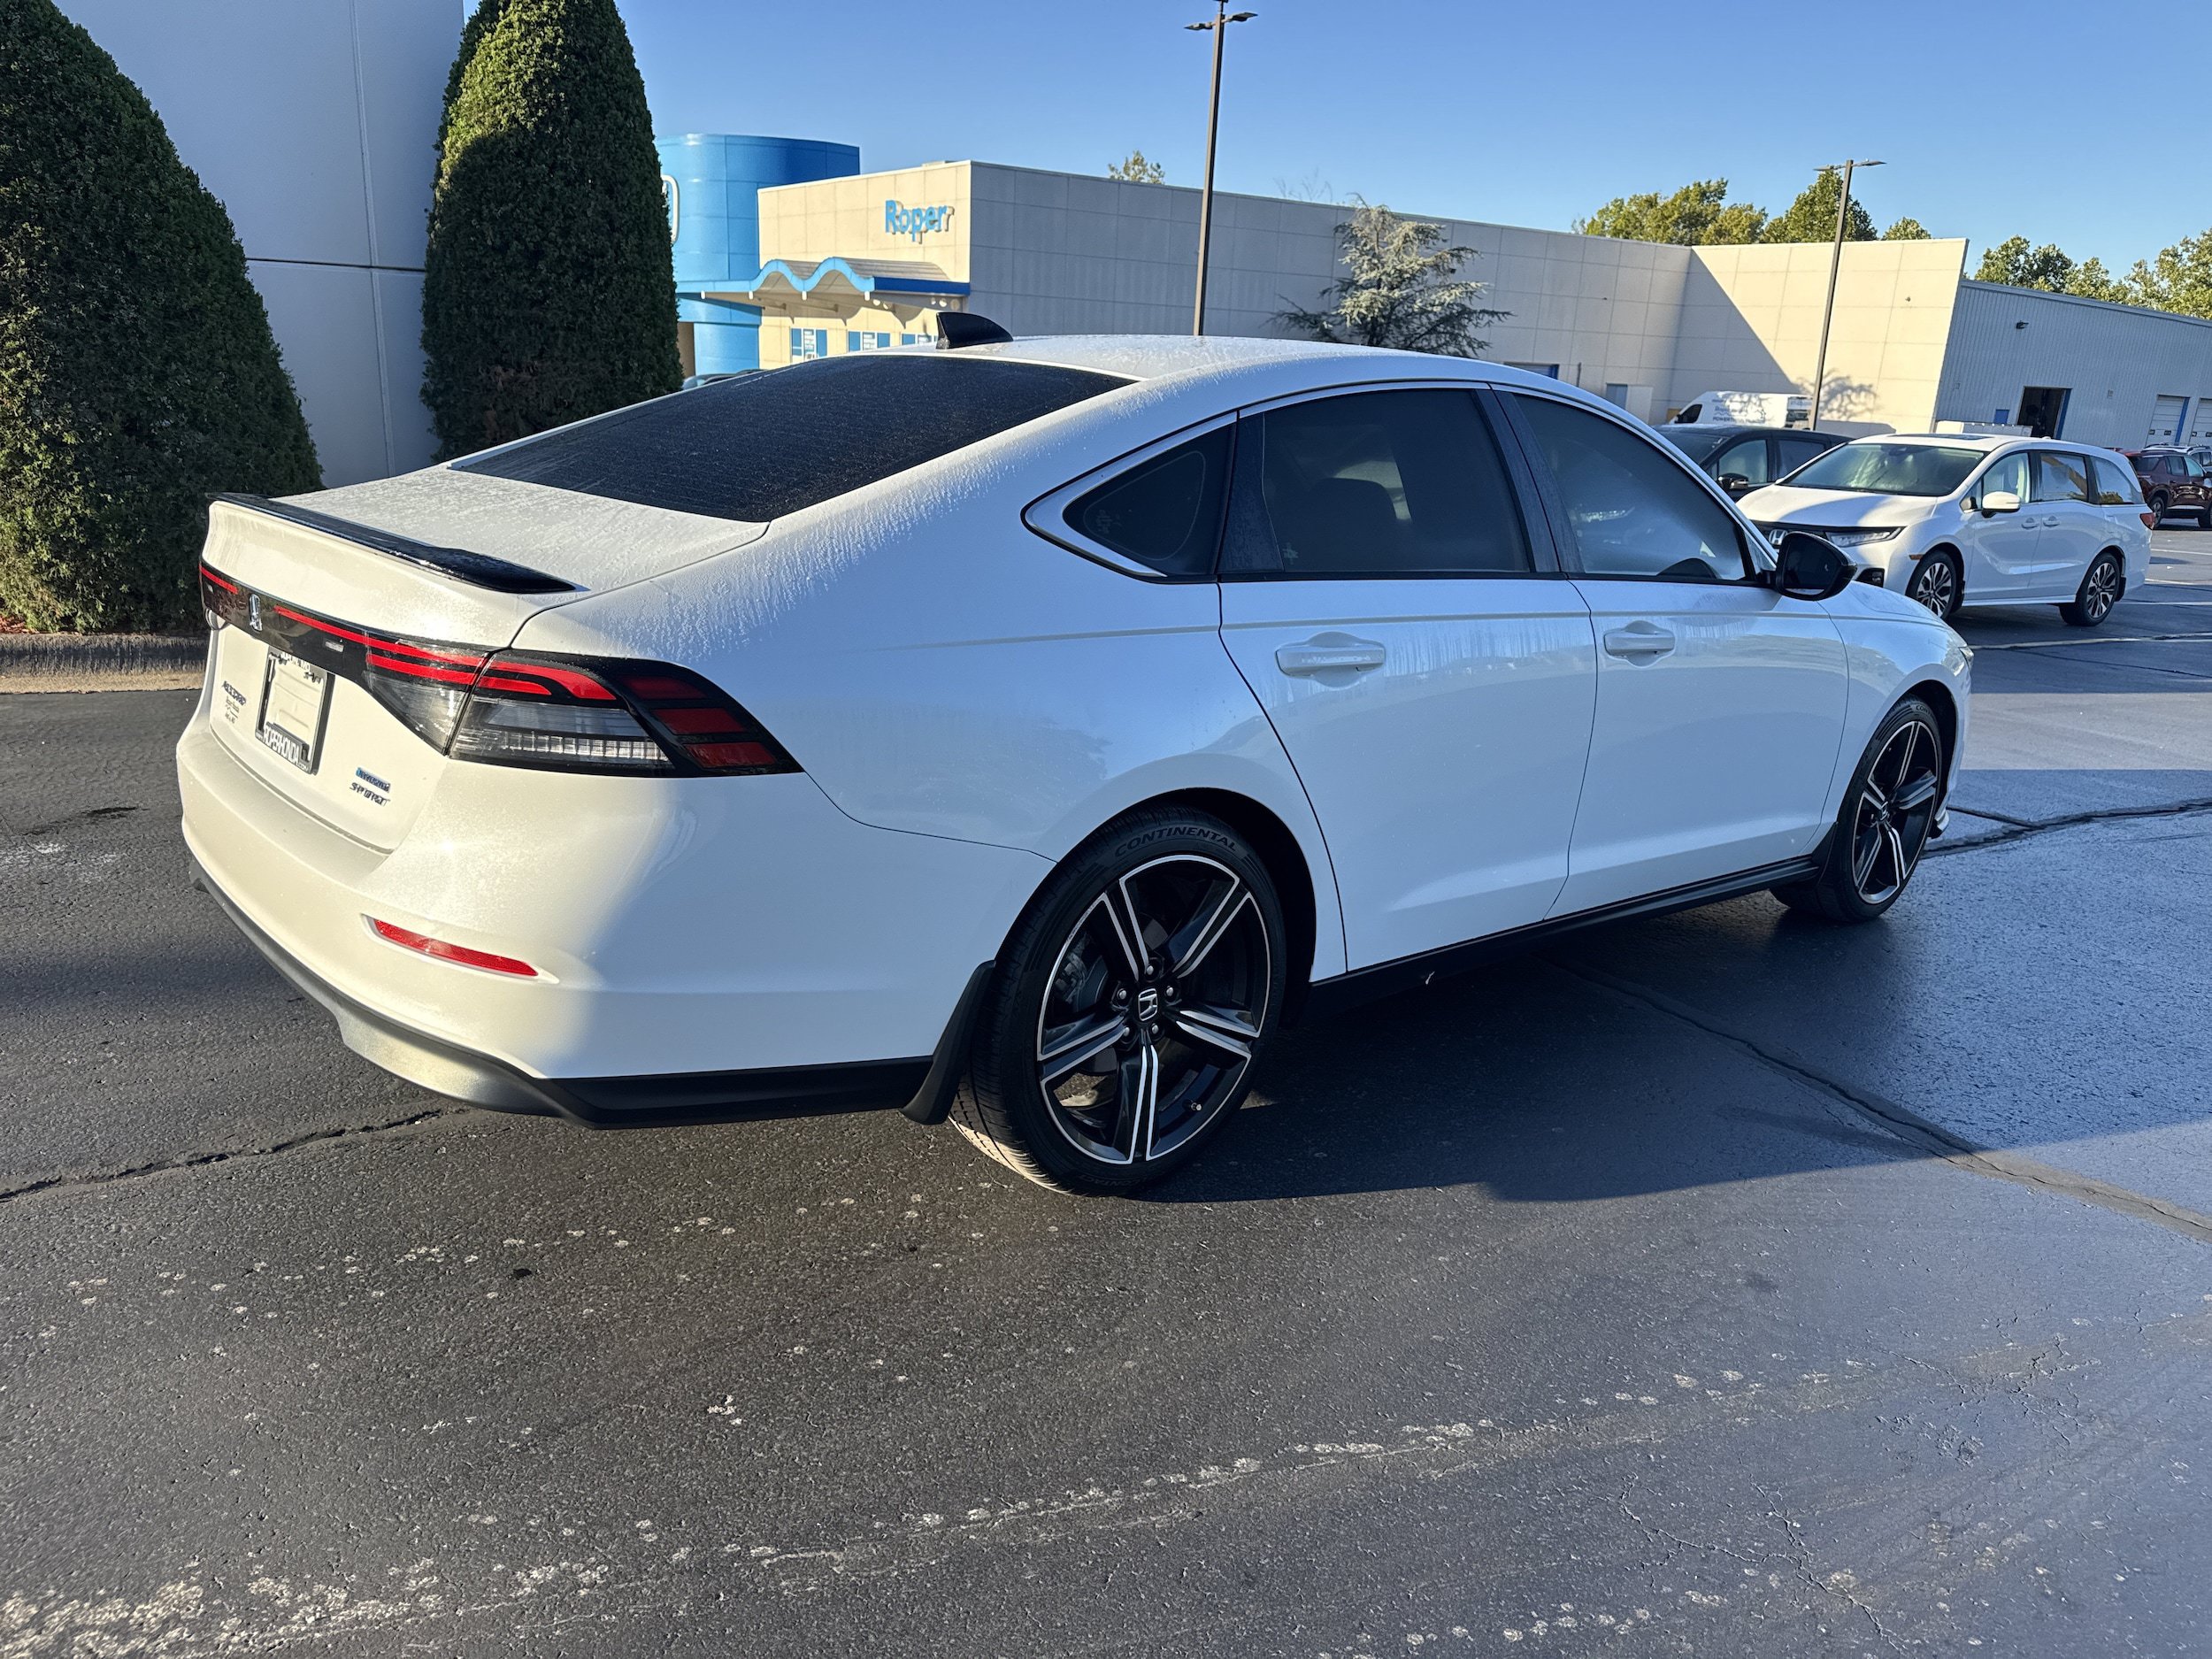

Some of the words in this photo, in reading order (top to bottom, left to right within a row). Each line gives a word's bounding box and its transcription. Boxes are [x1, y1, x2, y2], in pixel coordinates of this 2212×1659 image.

[886, 200, 949, 242] Roper
[349, 782, 391, 807] SPORT
[1115, 826, 1236, 857] CONTINENTAL
